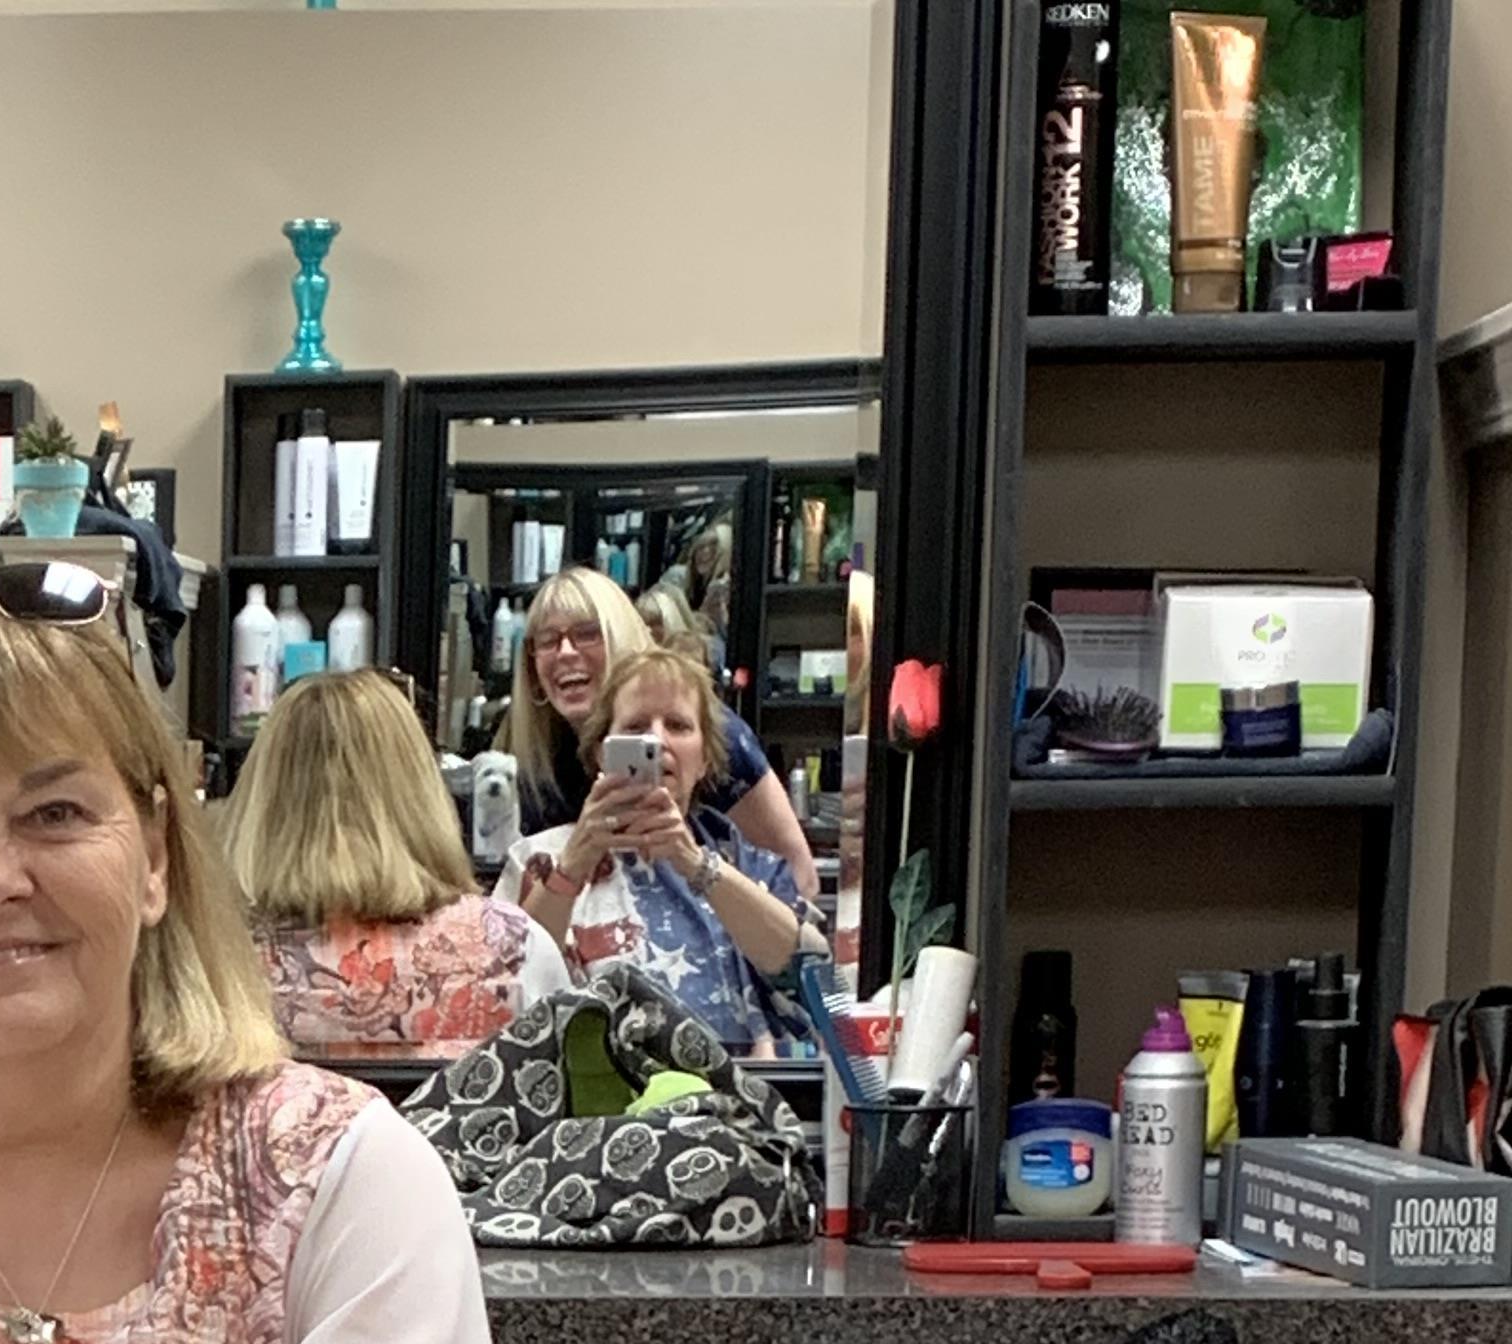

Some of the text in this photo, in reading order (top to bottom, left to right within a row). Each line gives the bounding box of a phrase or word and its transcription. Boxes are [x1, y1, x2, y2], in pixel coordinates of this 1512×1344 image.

[1042, 106, 1083, 166] 12
[1055, 162, 1081, 251] WORK
[1191, 134, 1215, 234] TAME
[1124, 1101, 1167, 1123] BED
[1391, 1196, 1498, 1228] BLOWOUT
[1390, 1226, 1496, 1256] BRAZILIAN
